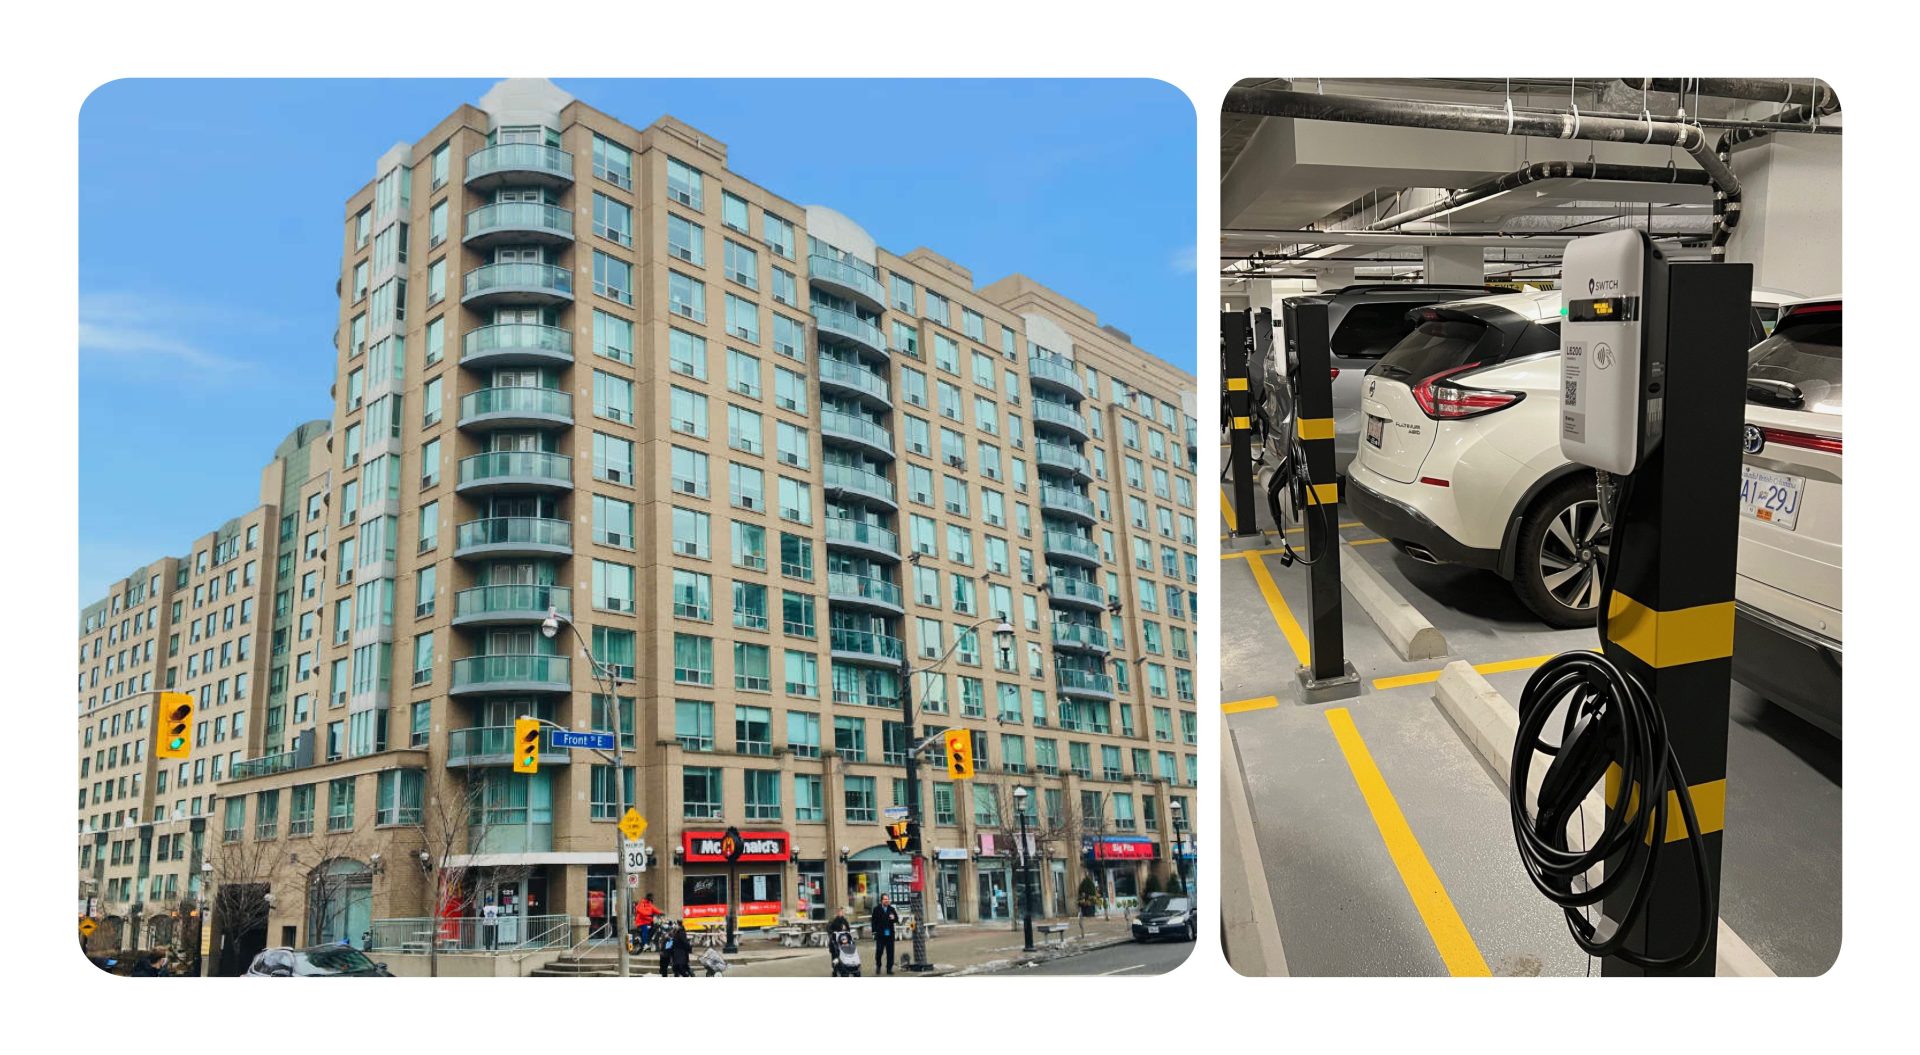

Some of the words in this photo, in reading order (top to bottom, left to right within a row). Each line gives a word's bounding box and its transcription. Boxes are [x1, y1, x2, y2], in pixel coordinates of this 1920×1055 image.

[1595, 279, 1619, 291] SWTCH
[1765, 485, 1798, 514] 29J
[563, 733, 588, 746] Front
[597, 735, 603, 747] E
[701, 840, 779, 854] Mcnald's
[628, 852, 644, 868] 30
